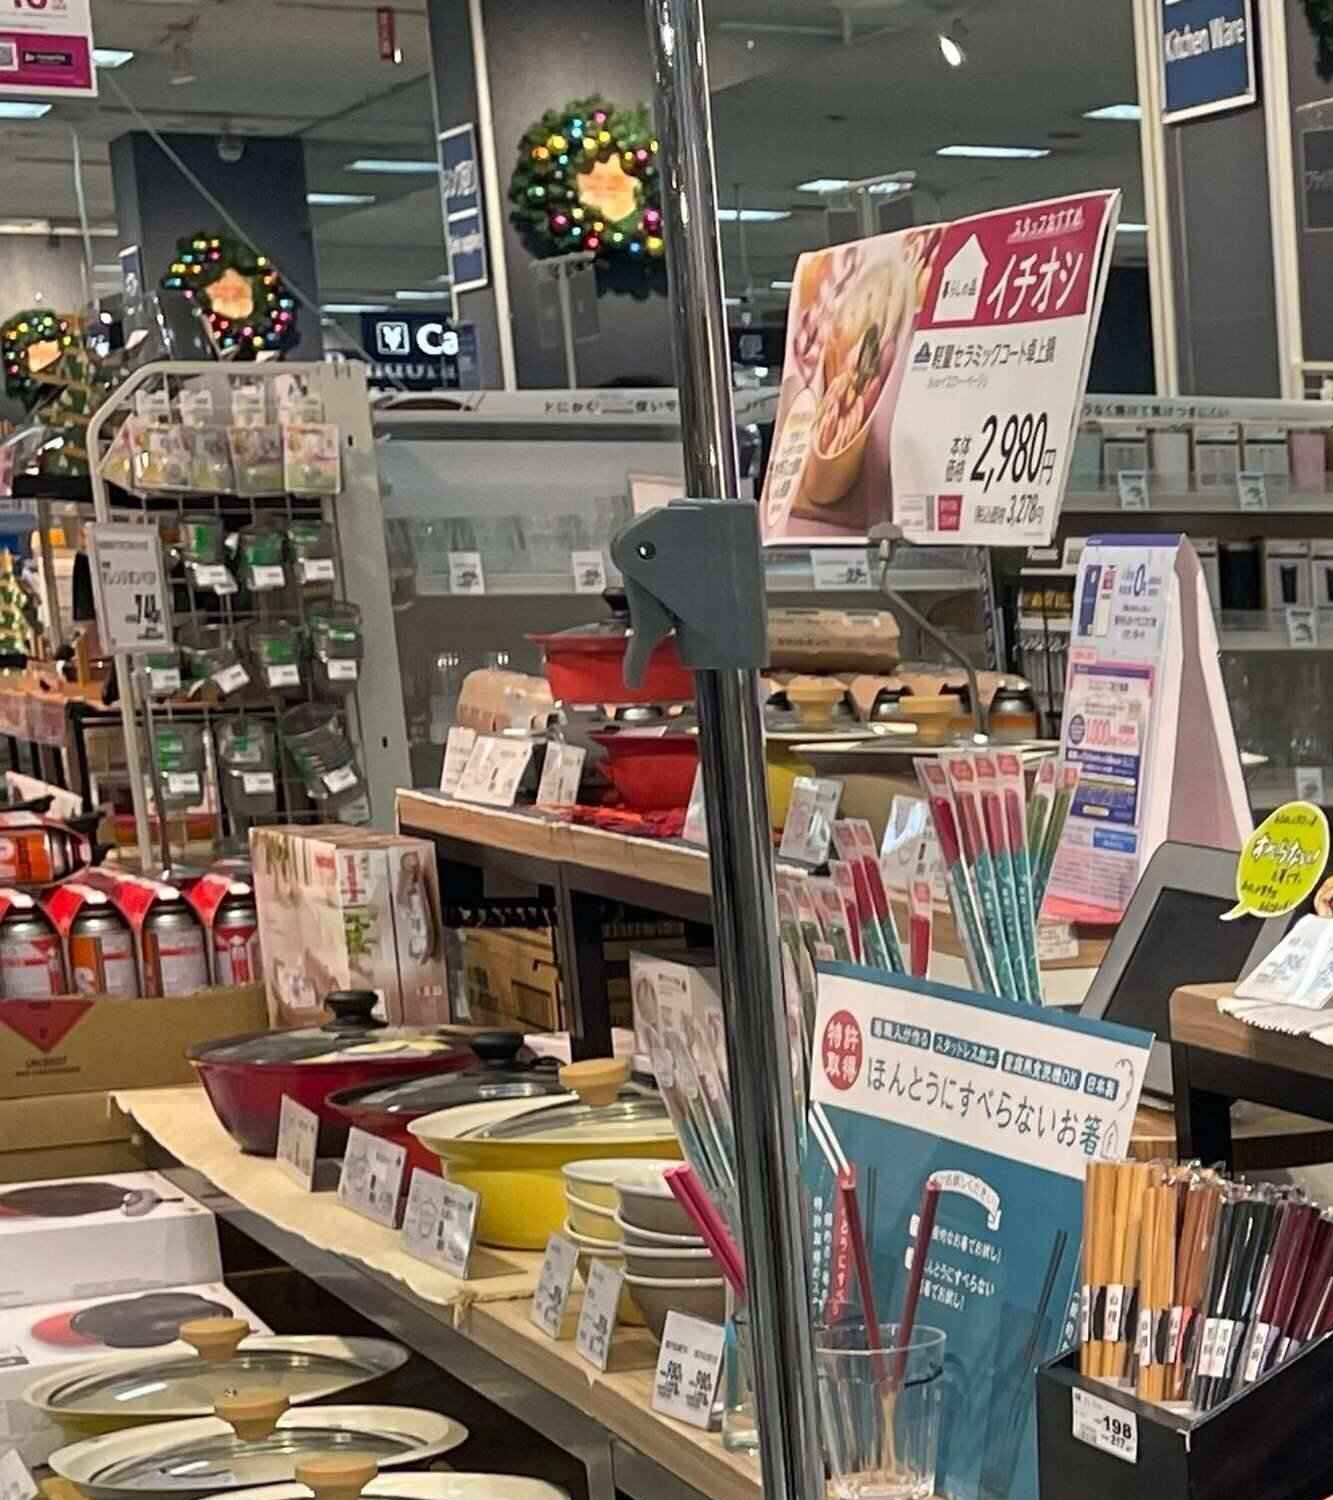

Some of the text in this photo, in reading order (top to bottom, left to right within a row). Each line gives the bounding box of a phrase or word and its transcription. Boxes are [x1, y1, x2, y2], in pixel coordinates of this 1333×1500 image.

[1209, 16, 1244, 50] Ware
[987, 247, 1084, 320] イチオシ
[970, 412, 1056, 493] 2,980円
[866, 1057, 1103, 1156] ほんとうにすべらないお箸
[1103, 1415, 1132, 1440] 198
